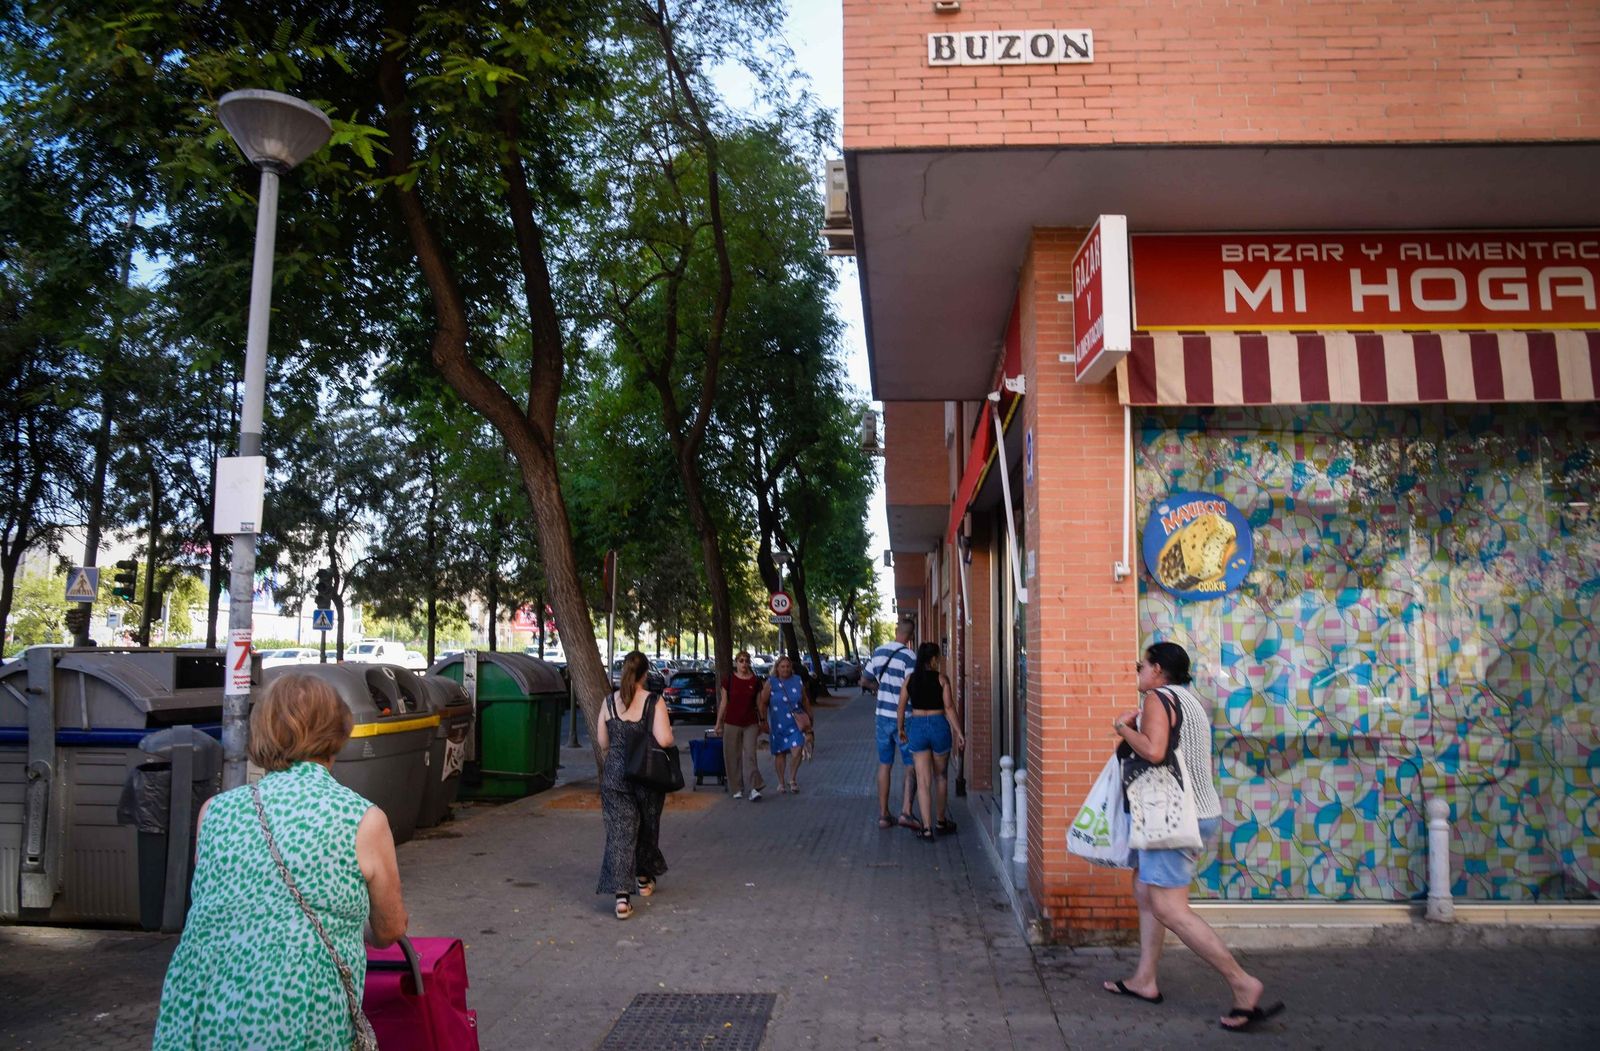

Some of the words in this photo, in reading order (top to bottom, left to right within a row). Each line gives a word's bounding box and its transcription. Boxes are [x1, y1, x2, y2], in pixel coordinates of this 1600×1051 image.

[932, 33, 1090, 61] BUZON
[1075, 233, 1101, 299] BAZAR
[1221, 243, 1344, 263] BAZAR
[1360, 243, 1383, 262] Y
[1400, 241, 1600, 261] ALIMENTAC
[1222, 268, 1307, 313] MI
[1350, 266, 1597, 313] HOGA
[1086, 290, 1092, 321] Y
[1160, 500, 1227, 536] MAXIBON
[1198, 581, 1227, 592] COOKIE
[774, 599, 787, 607] 30
[233, 641, 251, 670] 7
